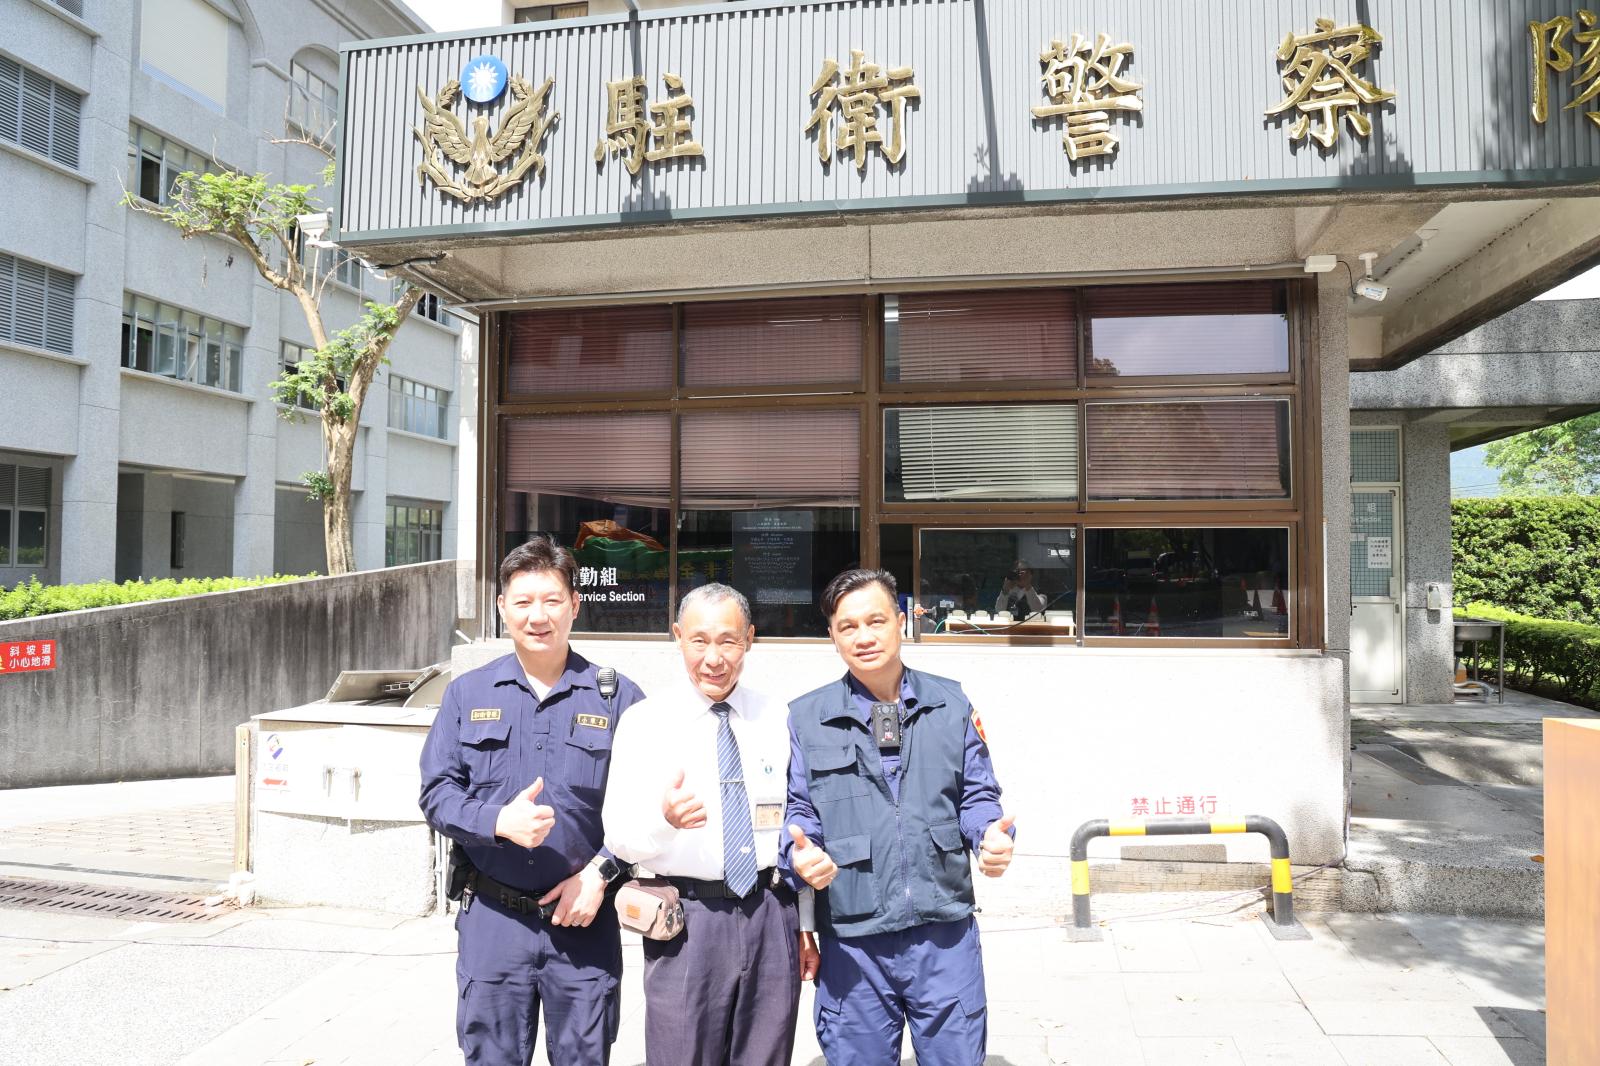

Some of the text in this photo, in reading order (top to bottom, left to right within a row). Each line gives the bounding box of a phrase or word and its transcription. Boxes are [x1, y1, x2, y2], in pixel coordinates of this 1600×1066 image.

[572, 567, 618, 587] 勤組
[578, 591, 645, 602] ervice Section
[9, 655, 51, 669] 小心地滑
[1131, 795, 1218, 815] 禁止通行
